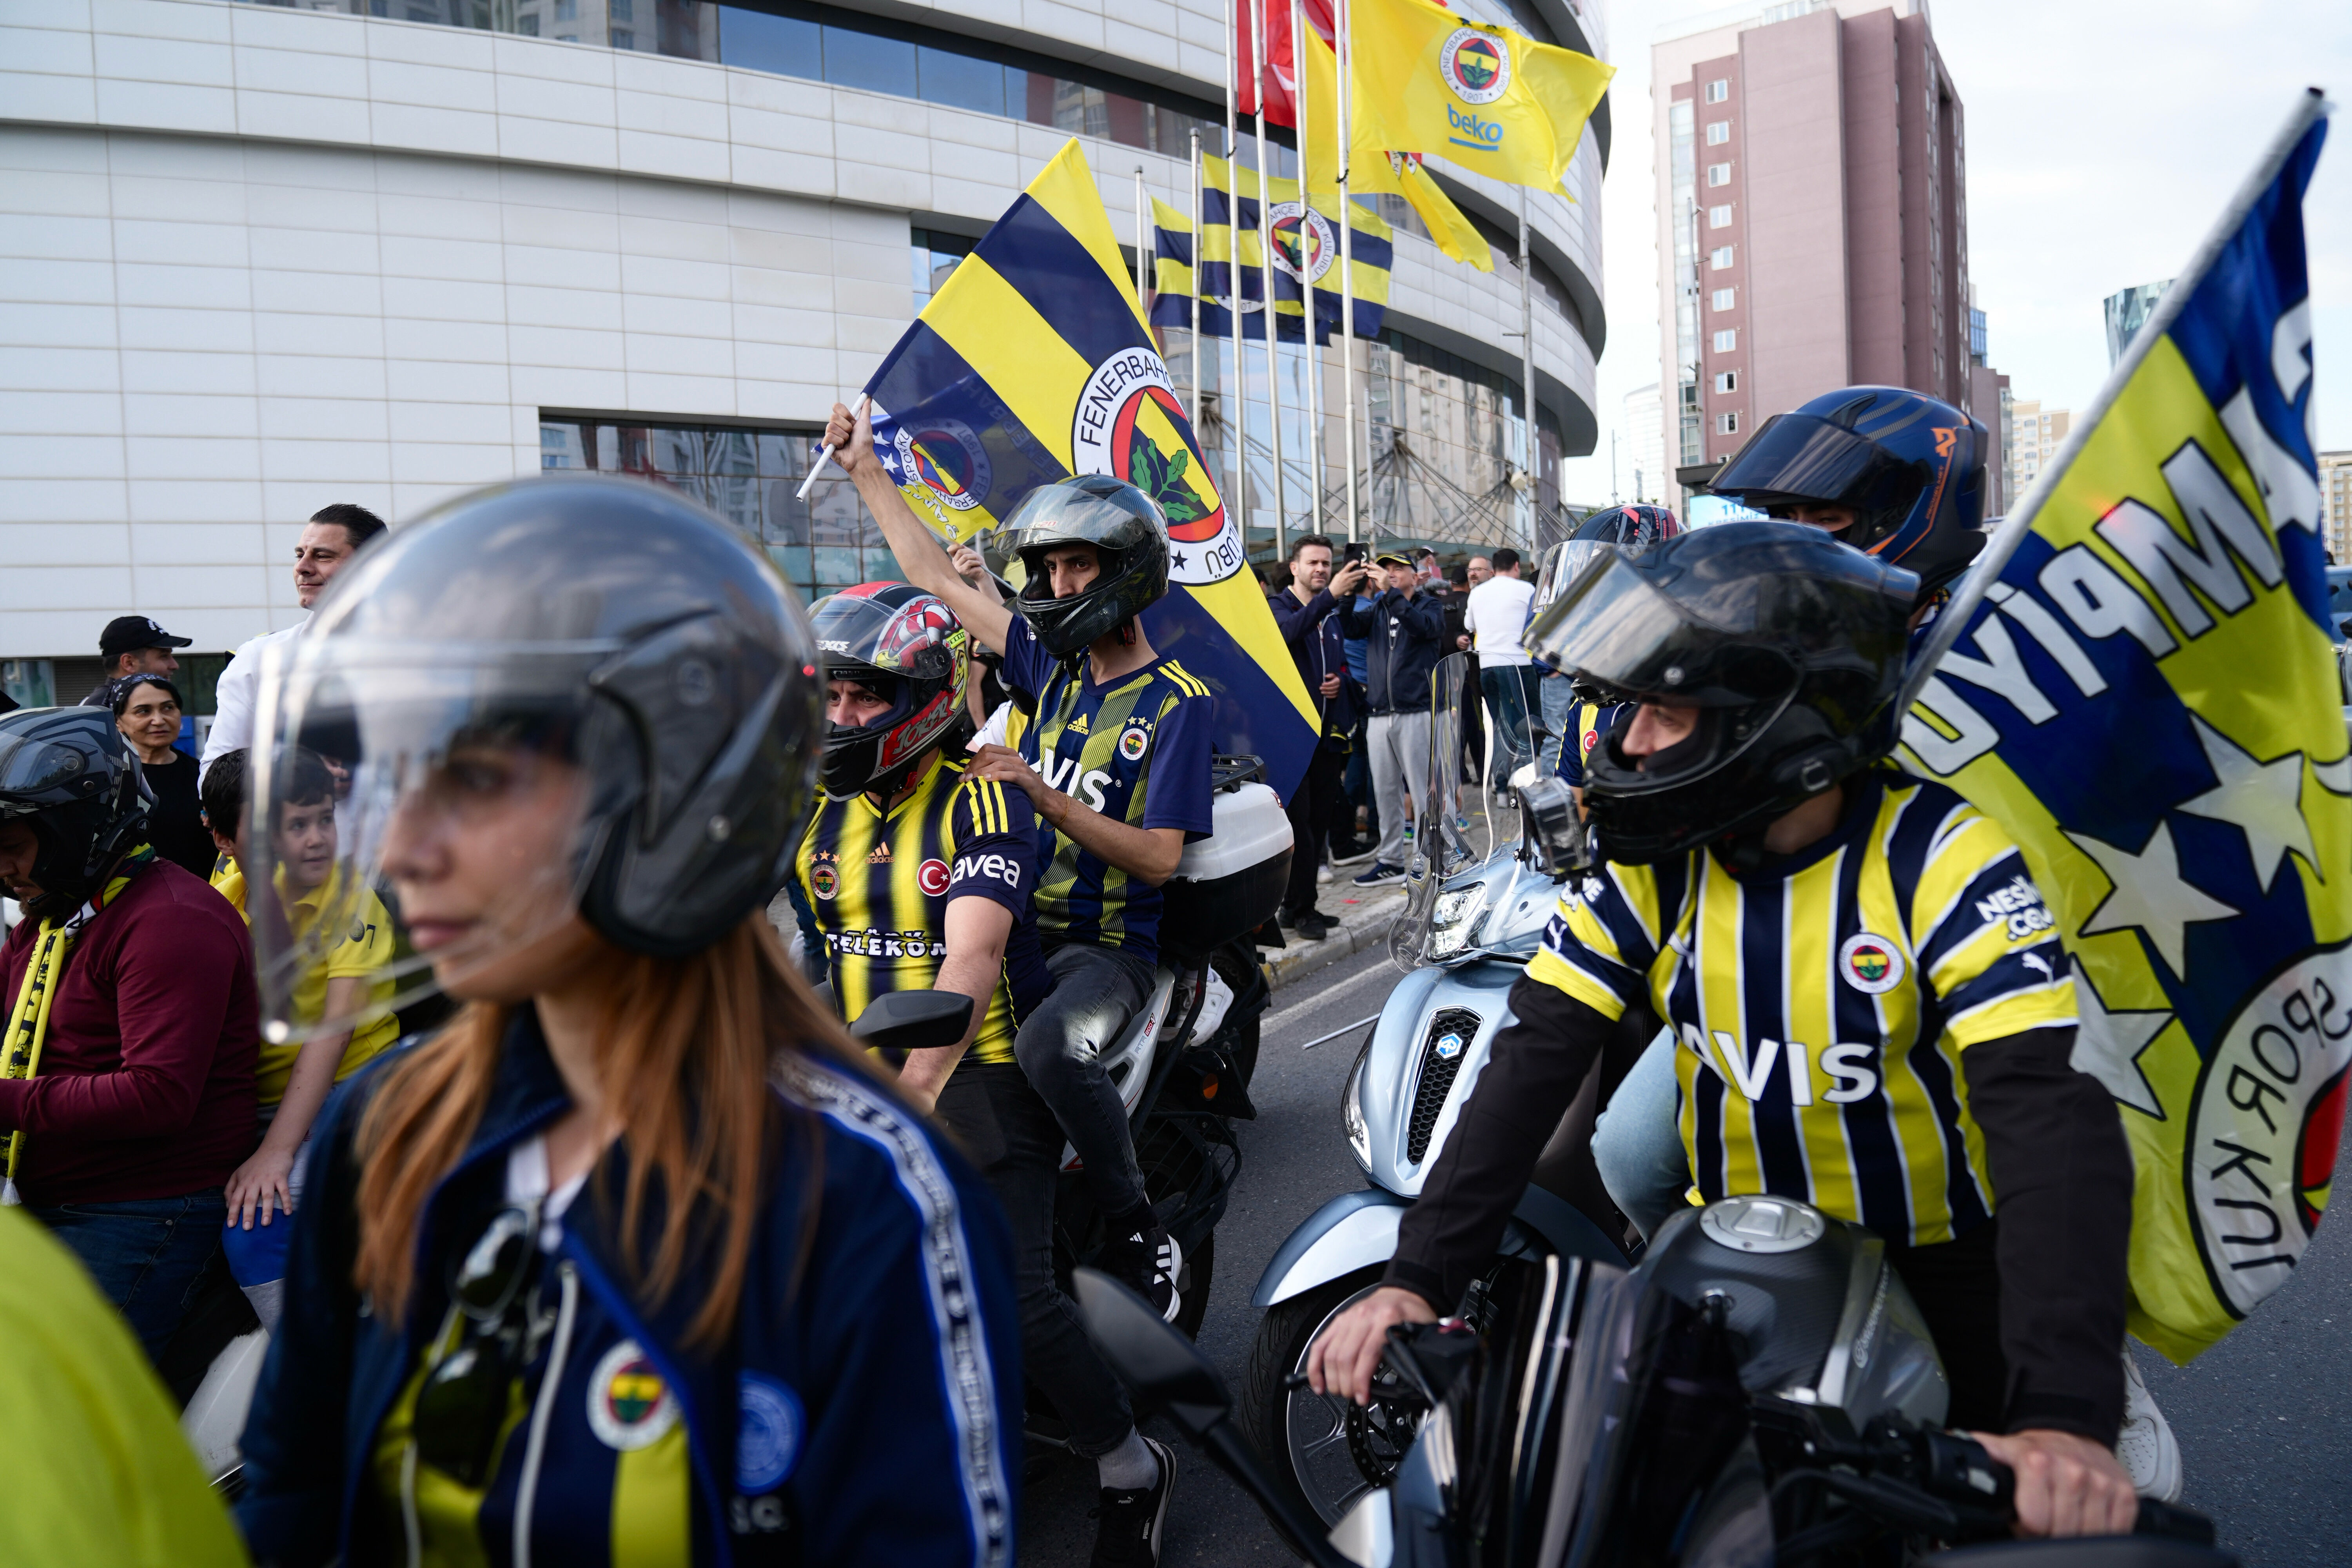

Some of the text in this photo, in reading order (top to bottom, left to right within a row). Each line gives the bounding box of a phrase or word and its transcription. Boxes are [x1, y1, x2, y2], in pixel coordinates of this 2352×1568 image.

[1443, 29, 1477, 82] FENERBAHÇE
[1462, 91, 1484, 102] 1907
[1447, 103, 1503, 143] beko
[1307, 210, 1325, 230] POR
[1081, 354, 1176, 447] FENERBAHÇ
[1205, 509, 1241, 579] ULÜBÜ
[892, 696, 948, 755] JOKER
[1067, 724, 1089, 735] adidas
[1029, 747, 1113, 813] VIS
[865, 855, 895, 864] adidas
[952, 855, 1020, 889] avea
[1145, 1022, 1153, 1035] 200
